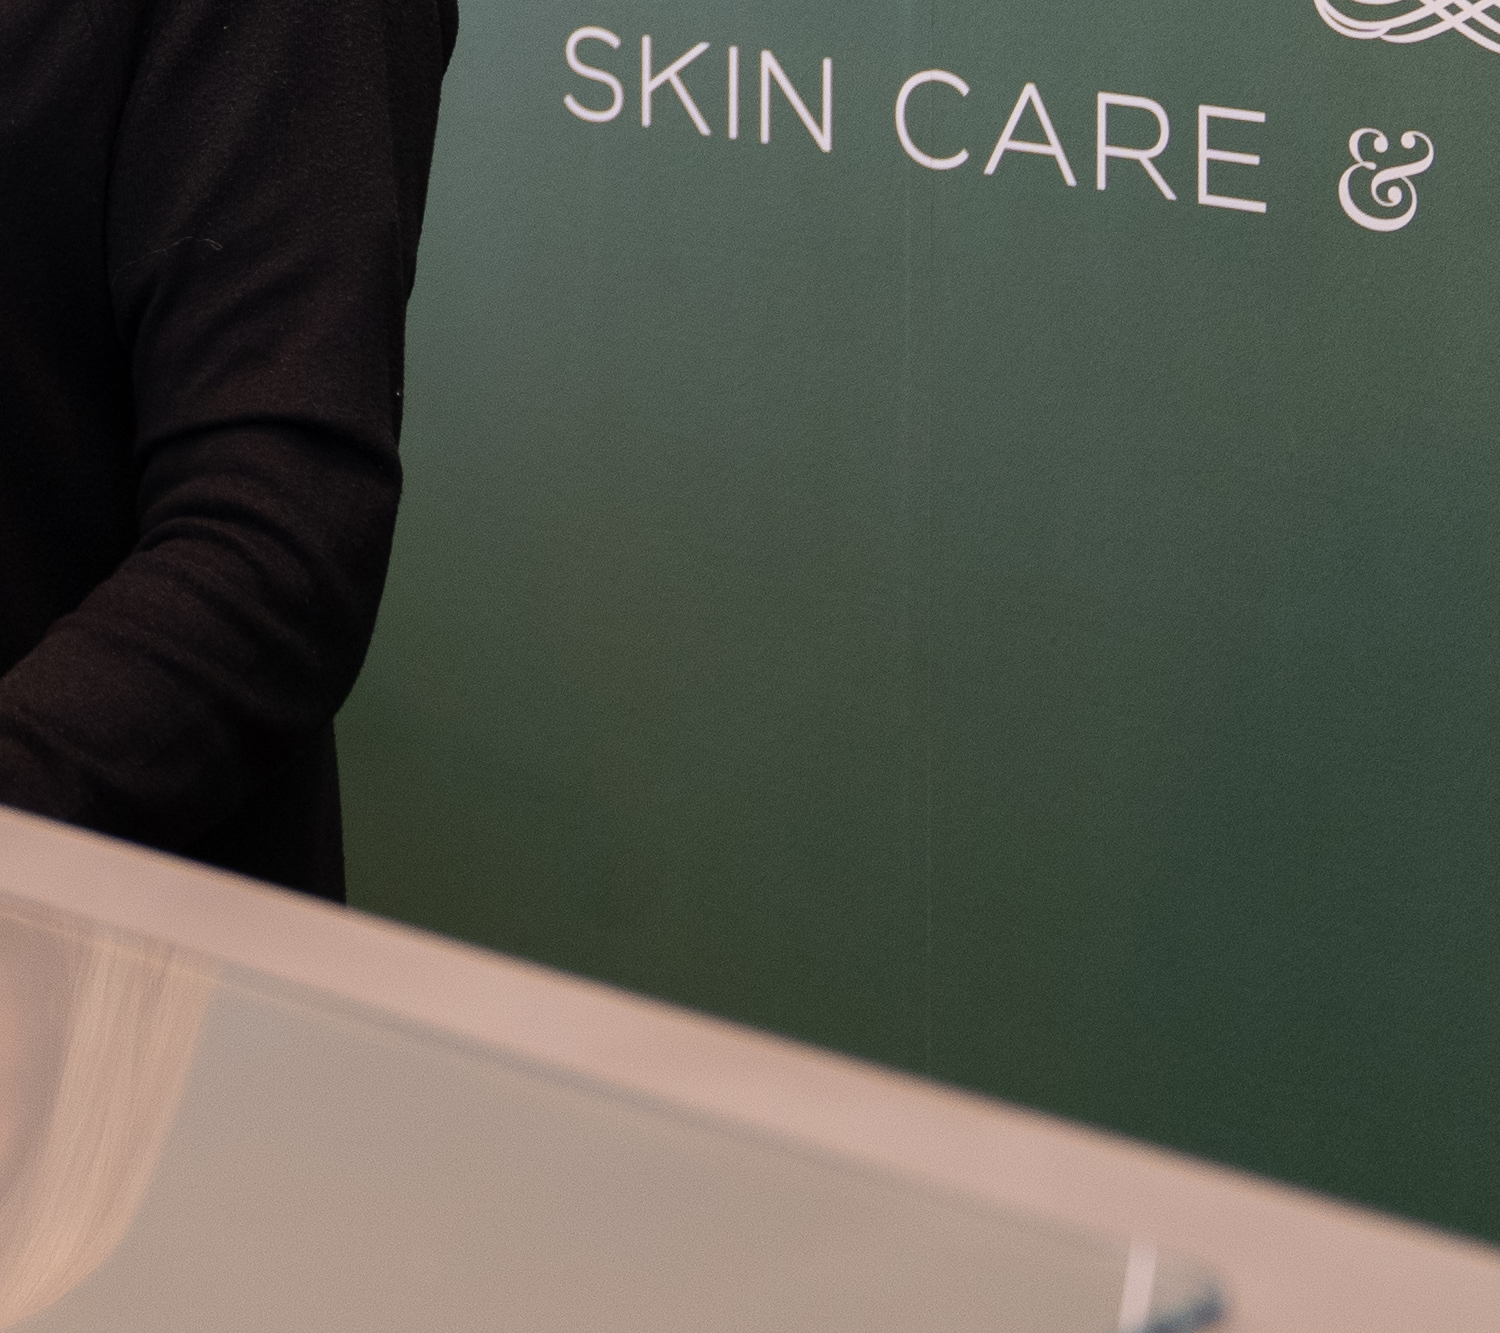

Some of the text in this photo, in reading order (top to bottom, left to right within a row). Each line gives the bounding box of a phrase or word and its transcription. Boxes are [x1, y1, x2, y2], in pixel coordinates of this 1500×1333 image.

[562, 25, 834, 154] SKIN
[892, 68, 1269, 214] CARE
[1337, 126, 1436, 233] &
